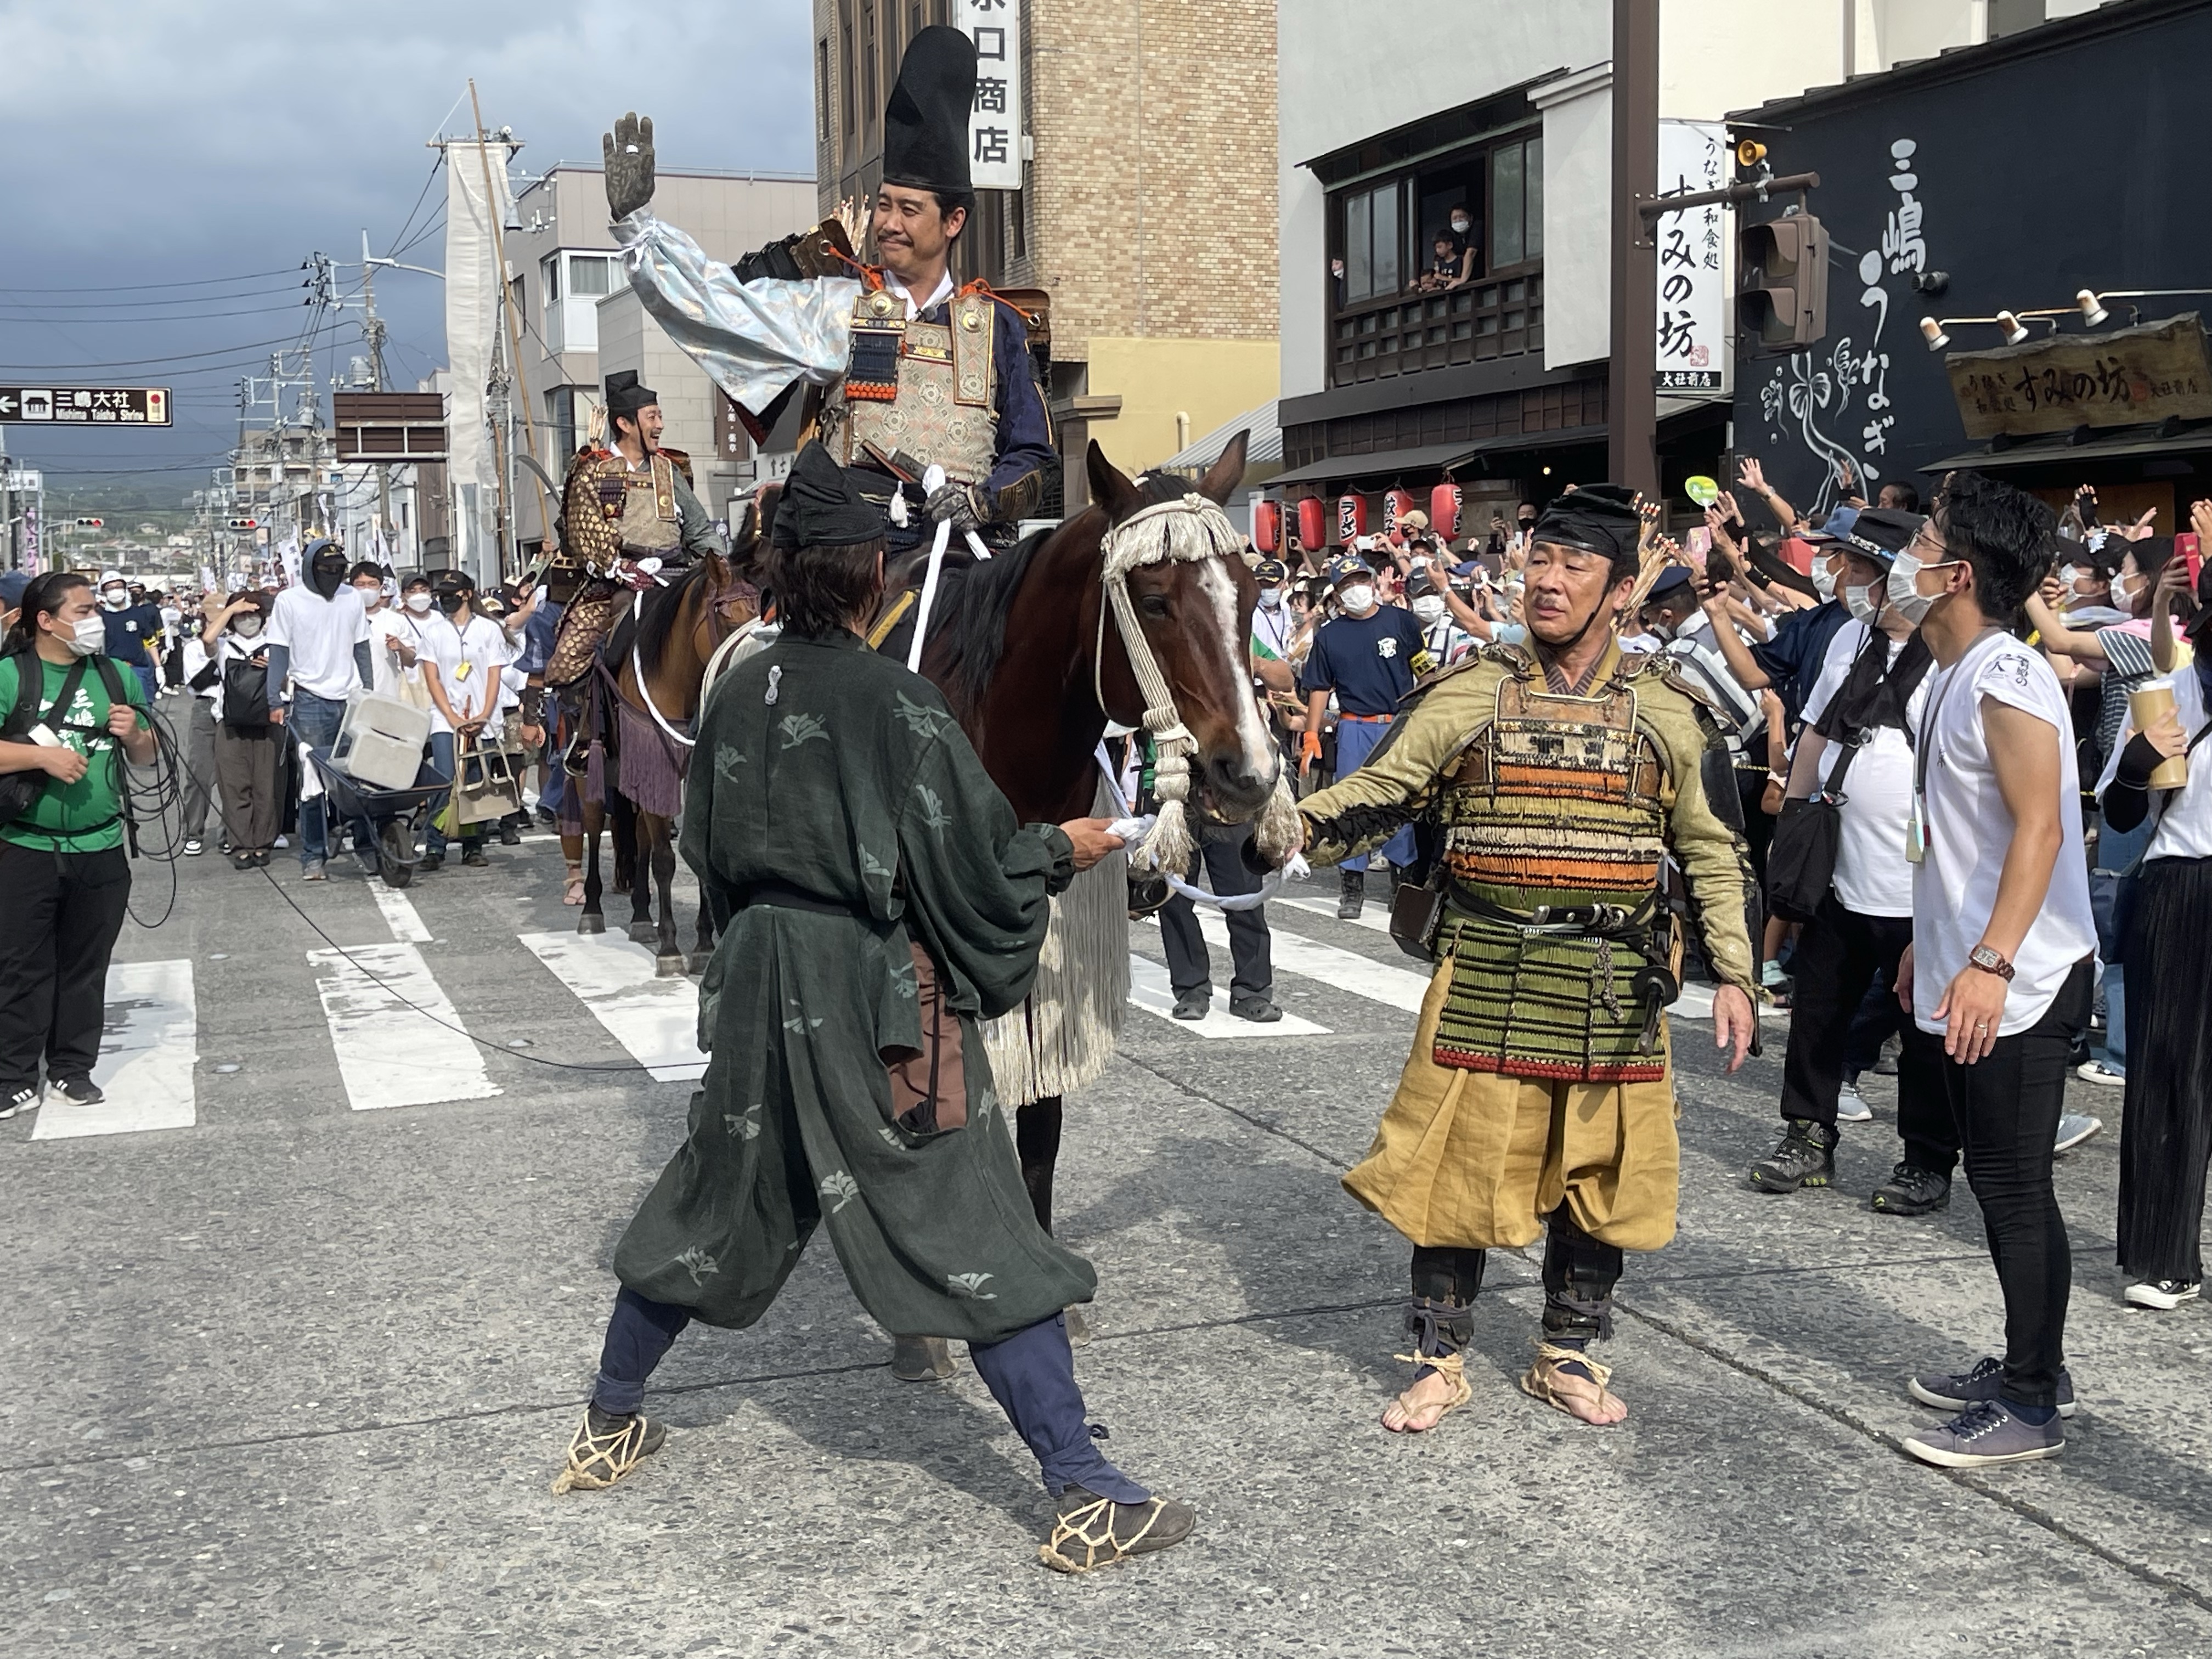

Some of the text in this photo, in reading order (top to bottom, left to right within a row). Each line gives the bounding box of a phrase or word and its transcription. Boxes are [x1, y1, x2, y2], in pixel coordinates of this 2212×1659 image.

[1883, 138, 1926, 275] 三嶋
[1702, 207, 1720, 269] 和食処
[1859, 250, 1894, 480] うなぎ
[2013, 357, 2131, 412] すみの坊
[56, 391, 131, 408] 三嶋大社
[56, 408, 145, 421] Mishima Taisha Shrine
[1341, 500, 1357, 540] ラーメン
